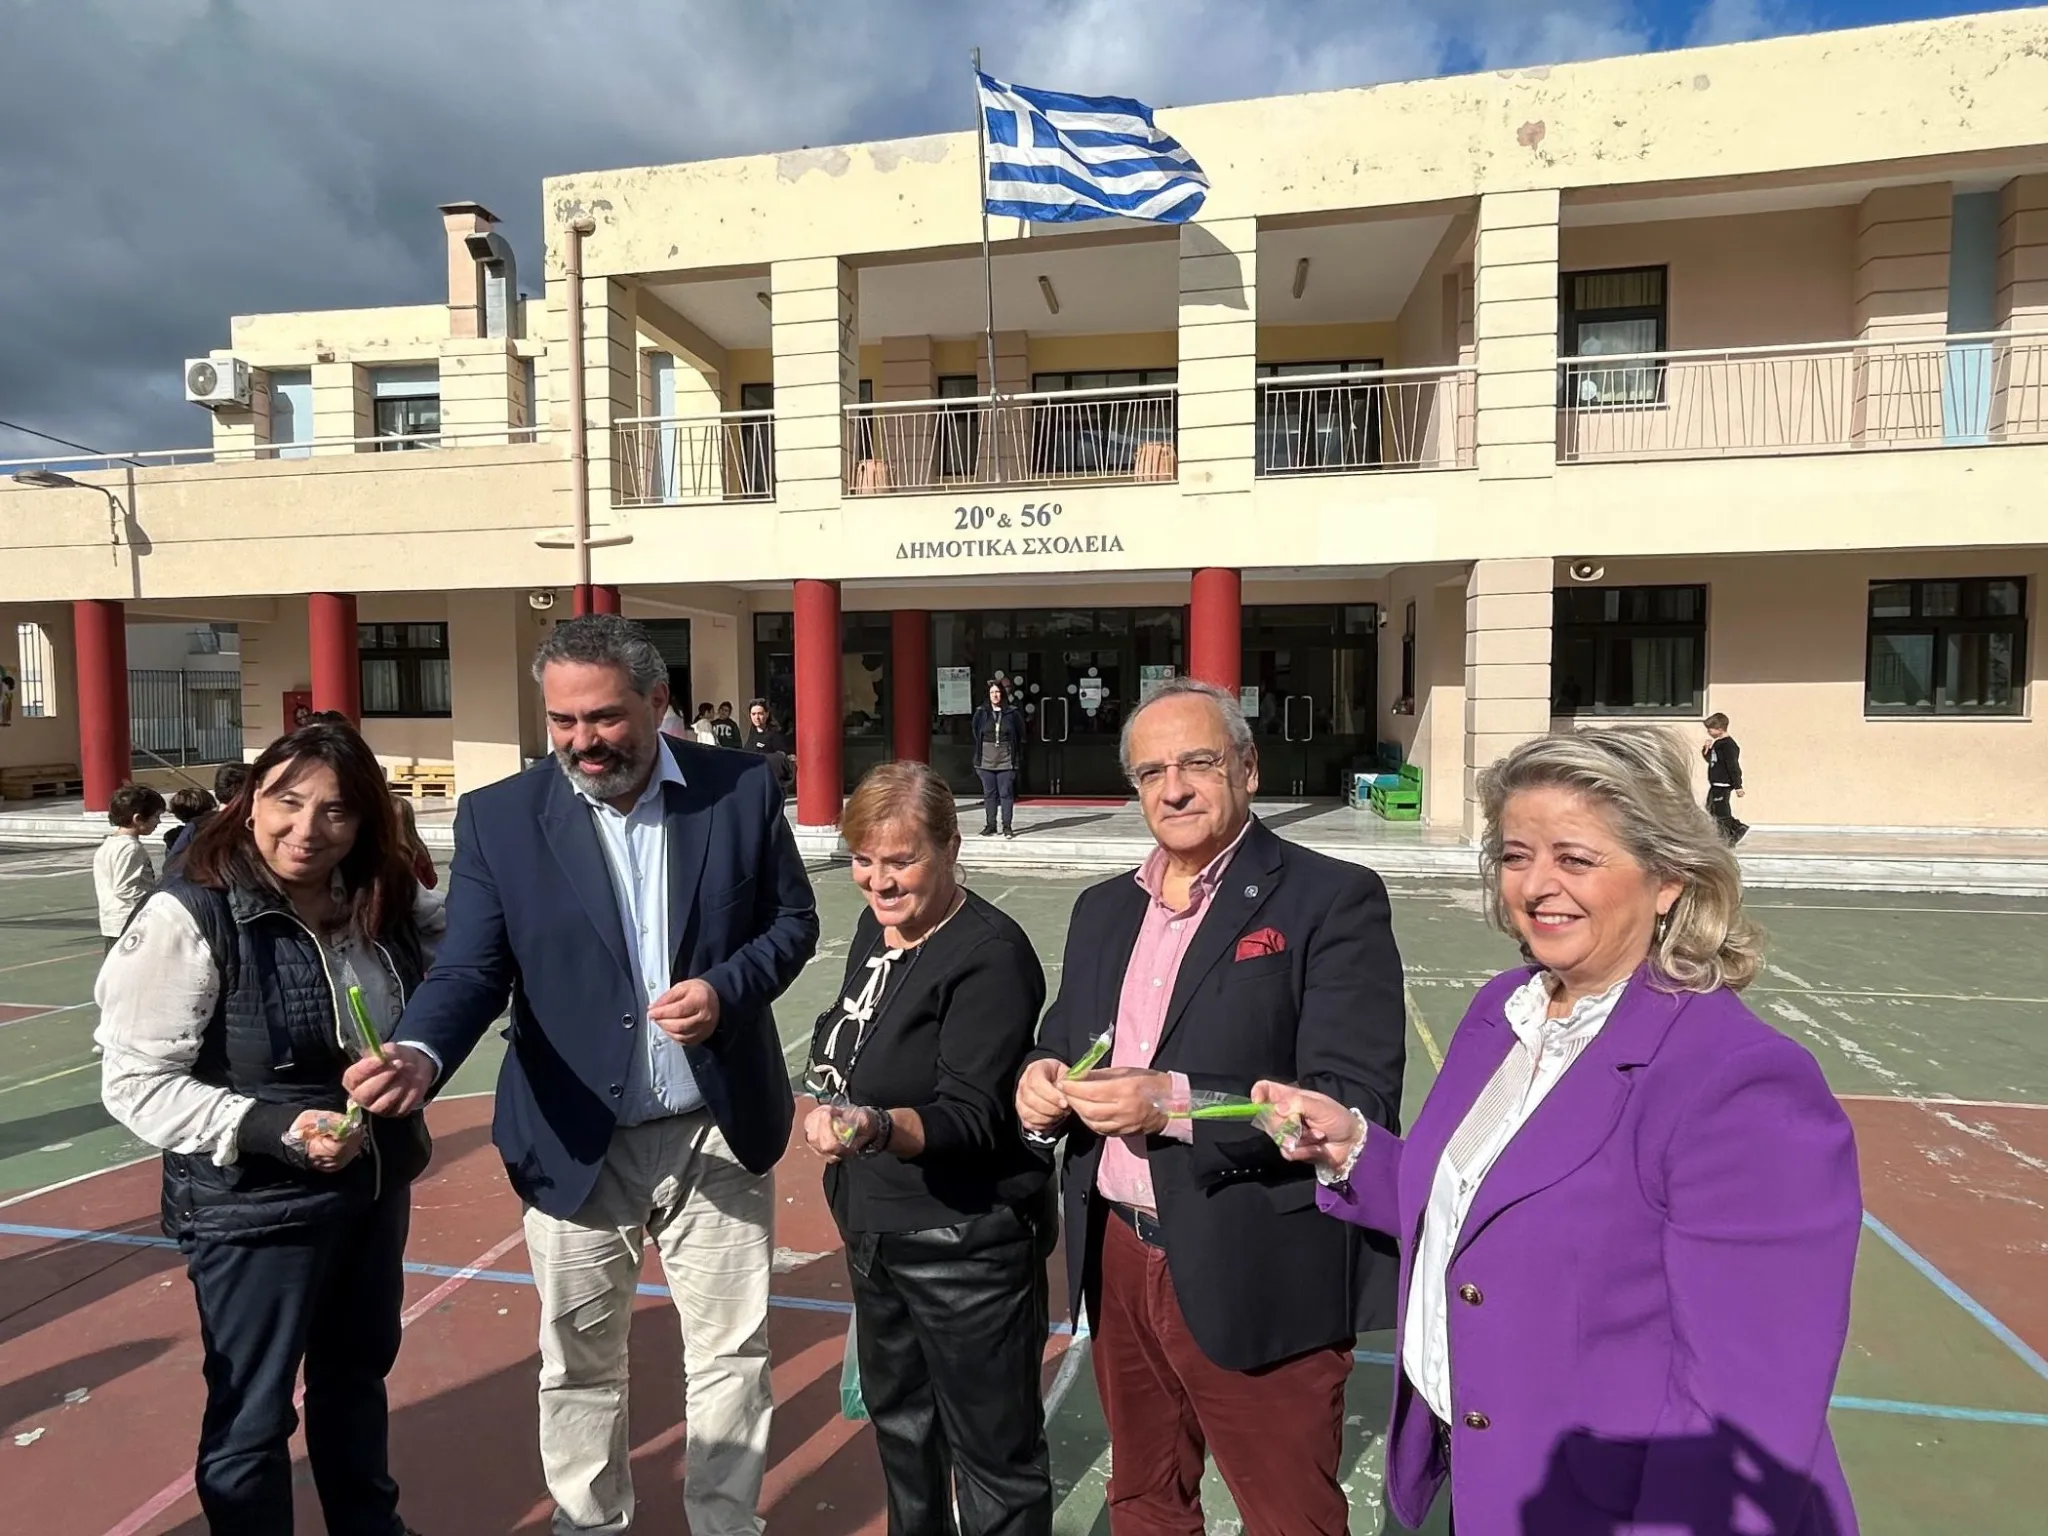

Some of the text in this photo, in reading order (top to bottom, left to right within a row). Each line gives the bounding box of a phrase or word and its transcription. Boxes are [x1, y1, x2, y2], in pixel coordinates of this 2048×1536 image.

[996, 513, 1012, 529] &
[895, 535, 1126, 560] ΔΗΜΟΤΙΚΑ ΣΧΟΛΕΙΑ
